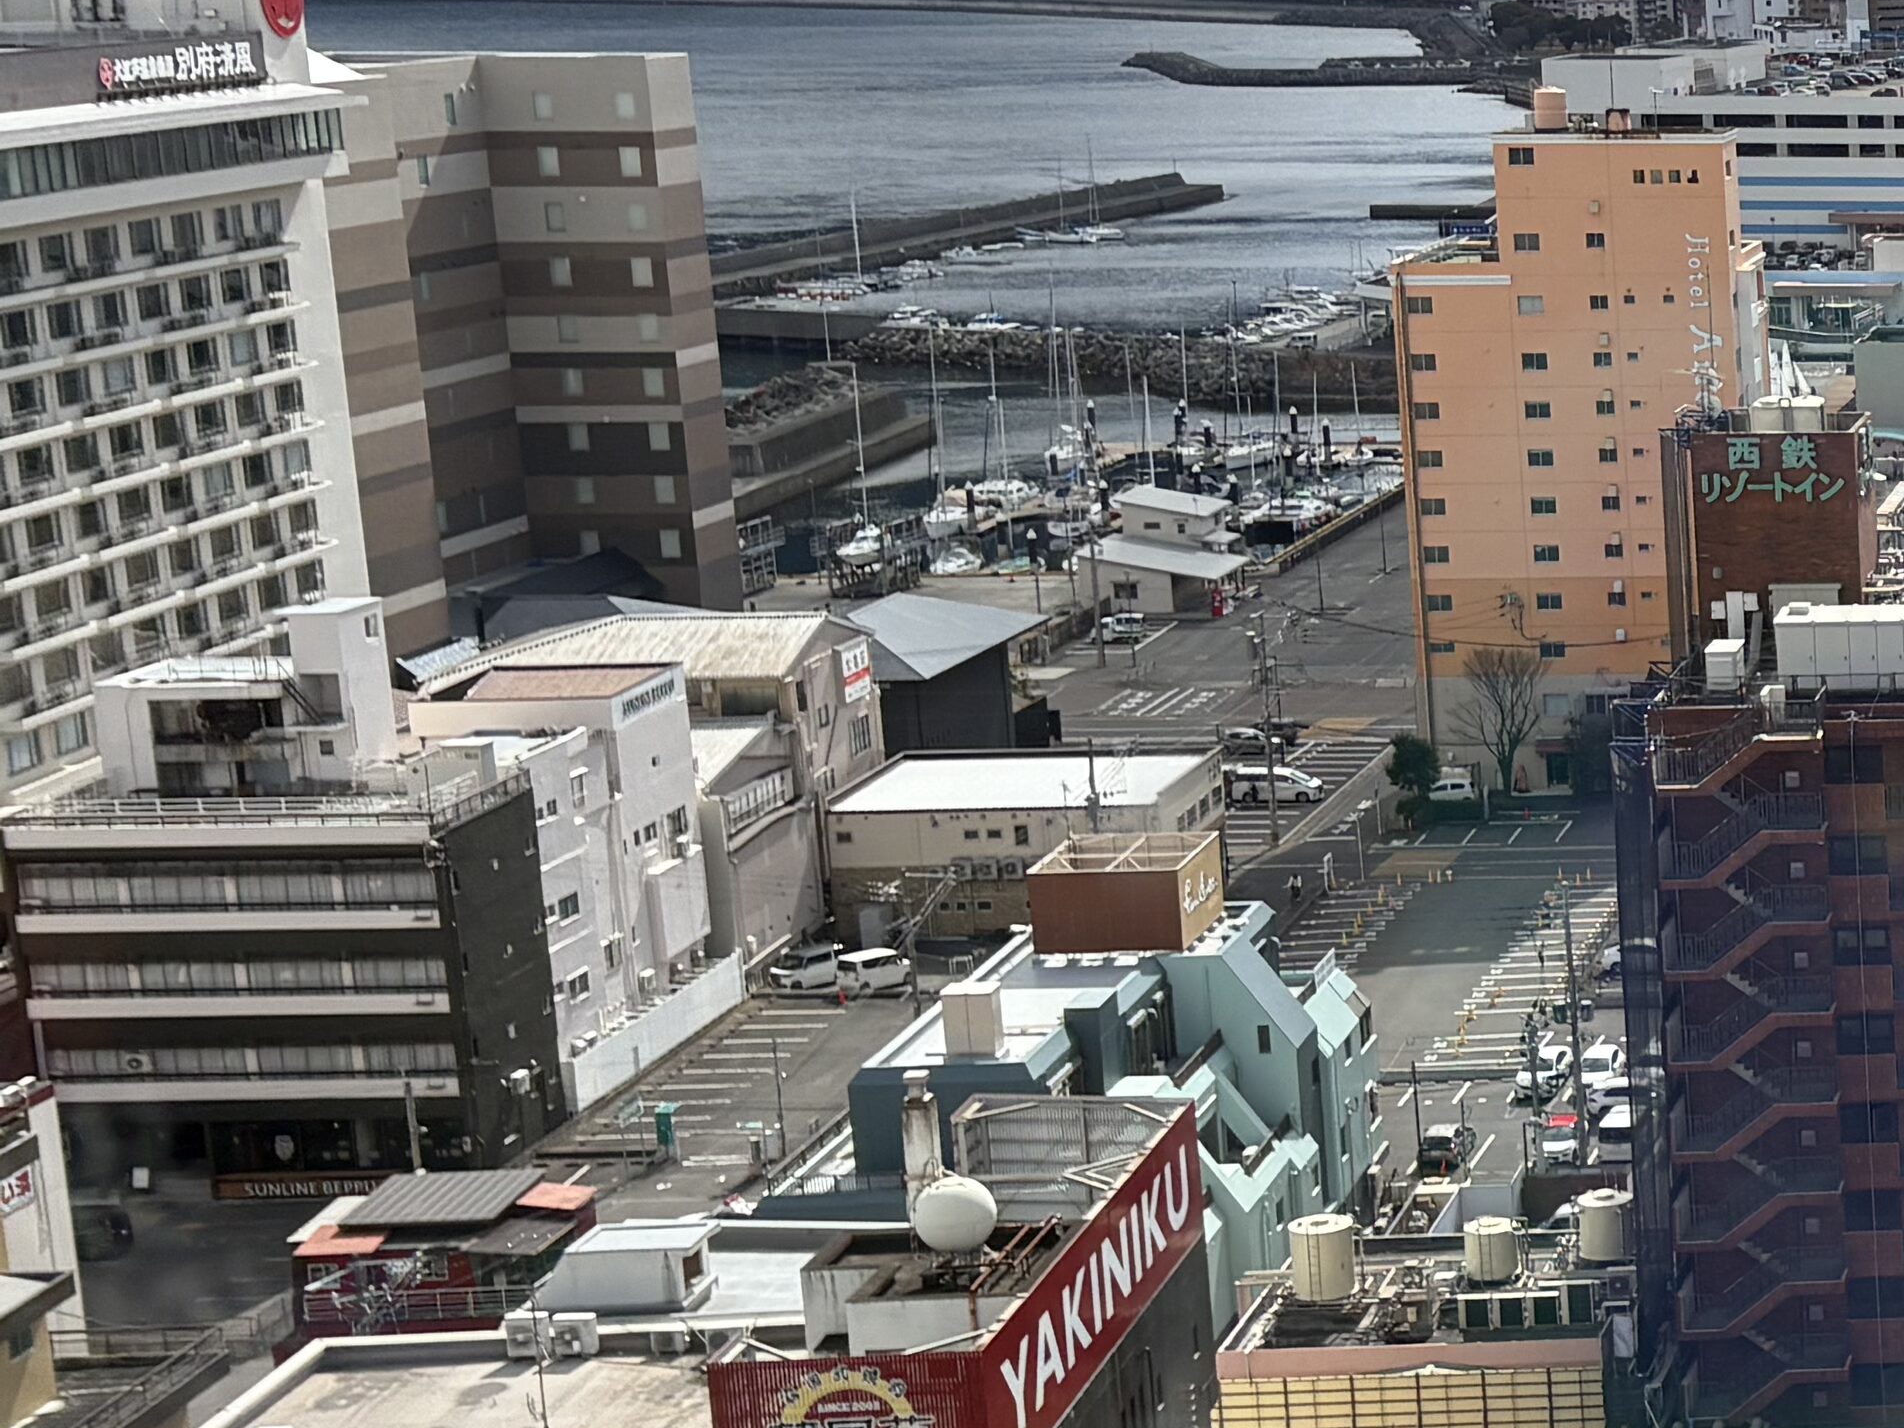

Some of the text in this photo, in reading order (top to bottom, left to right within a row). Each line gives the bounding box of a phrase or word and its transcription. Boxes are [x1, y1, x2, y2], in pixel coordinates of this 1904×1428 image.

[1727, 437, 1818, 471] 西鉄
[1701, 471, 1845, 504] リゾートイン
[243, 1181, 318, 1197] SUNLINE
